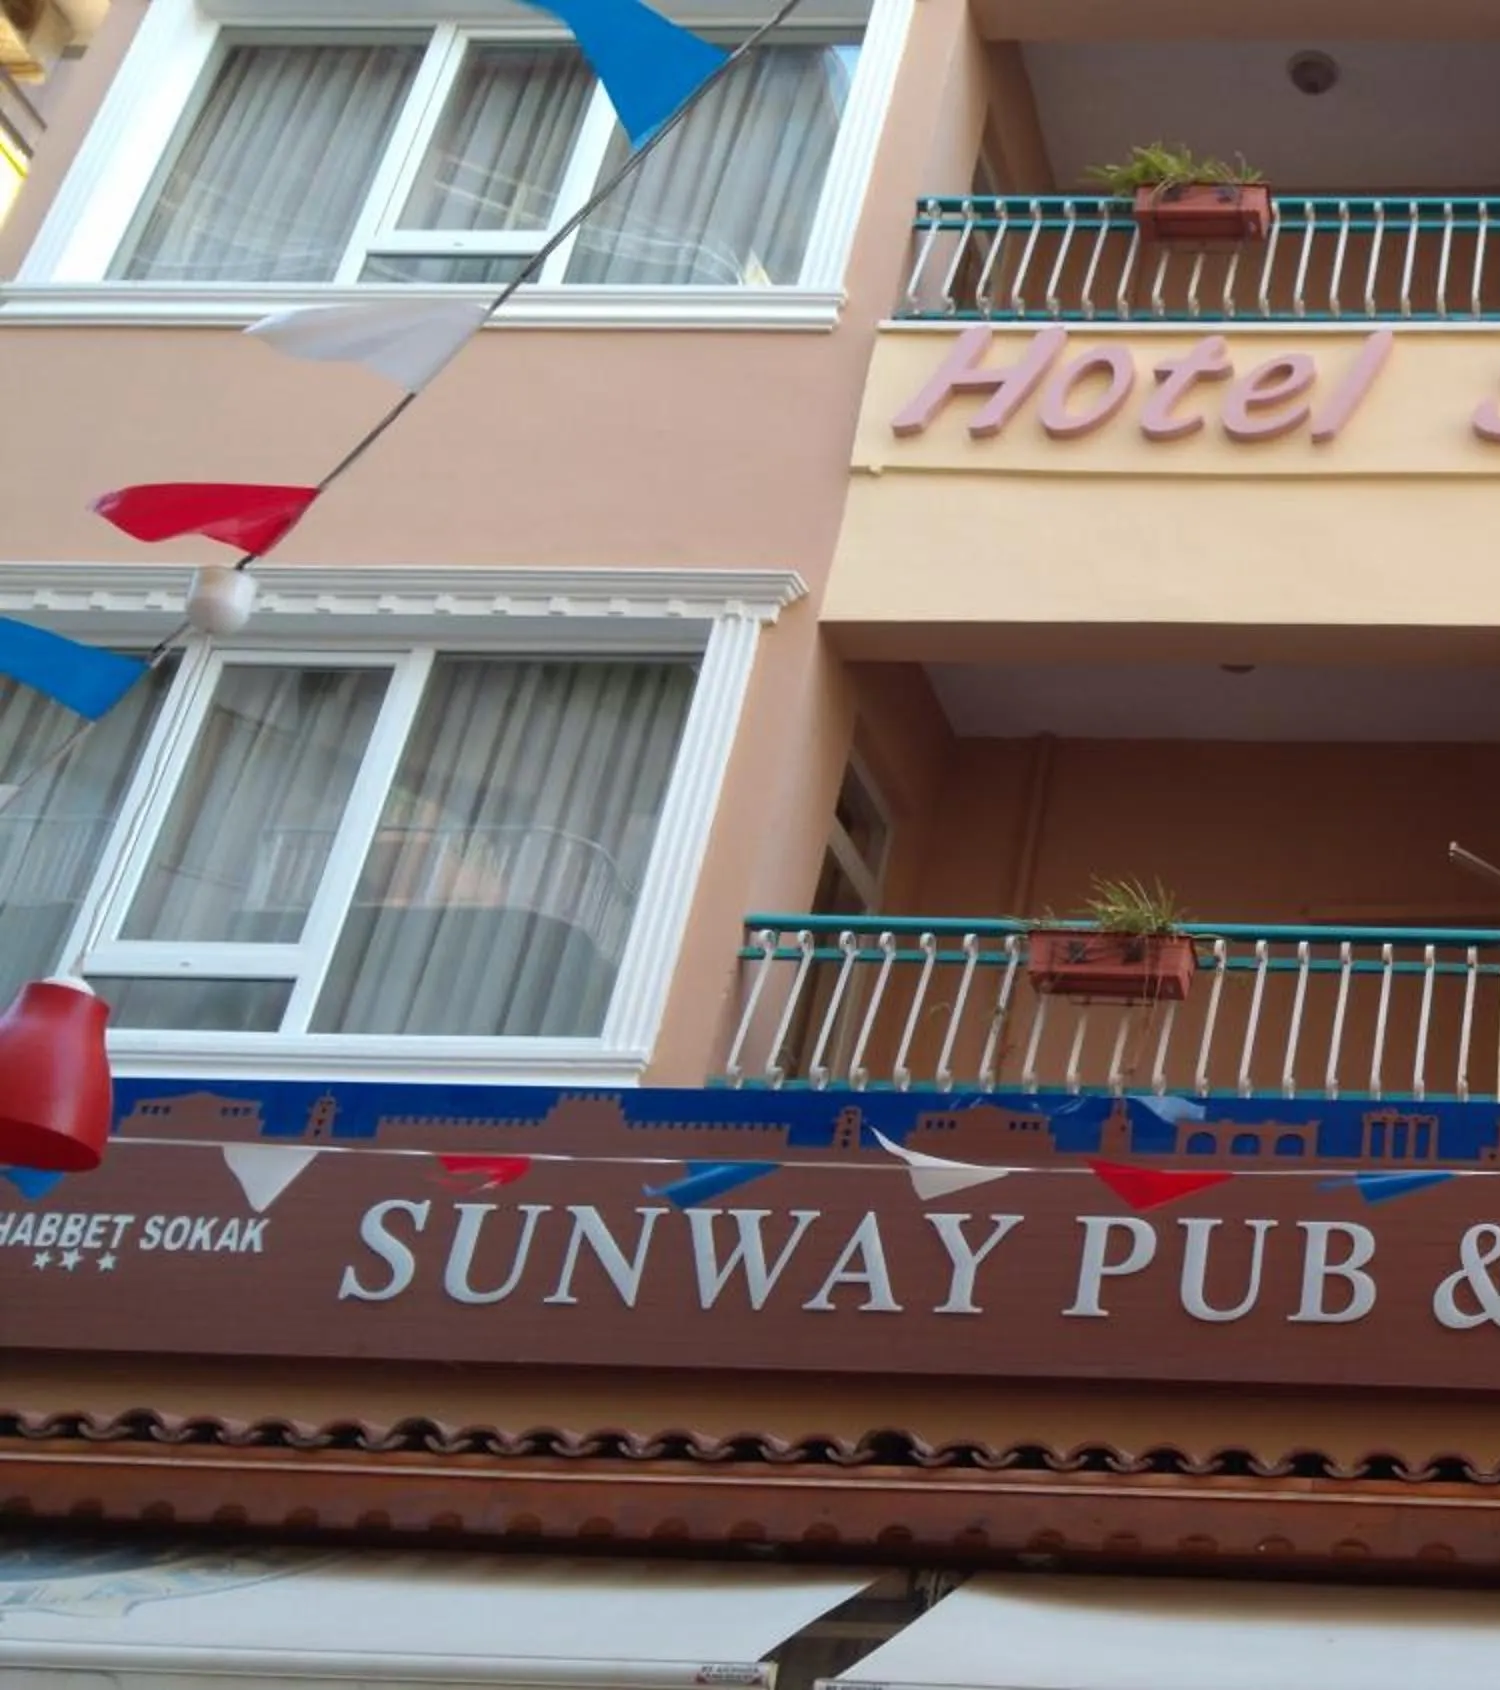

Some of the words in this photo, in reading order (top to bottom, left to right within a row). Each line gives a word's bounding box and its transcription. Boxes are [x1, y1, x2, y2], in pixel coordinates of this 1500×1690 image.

[893, 324, 1394, 444] Hotel
[139, 1215, 270, 1253] SOKAK
[338, 1199, 1024, 1314] SUNWAY
[1062, 1215, 1378, 1323] PUB
